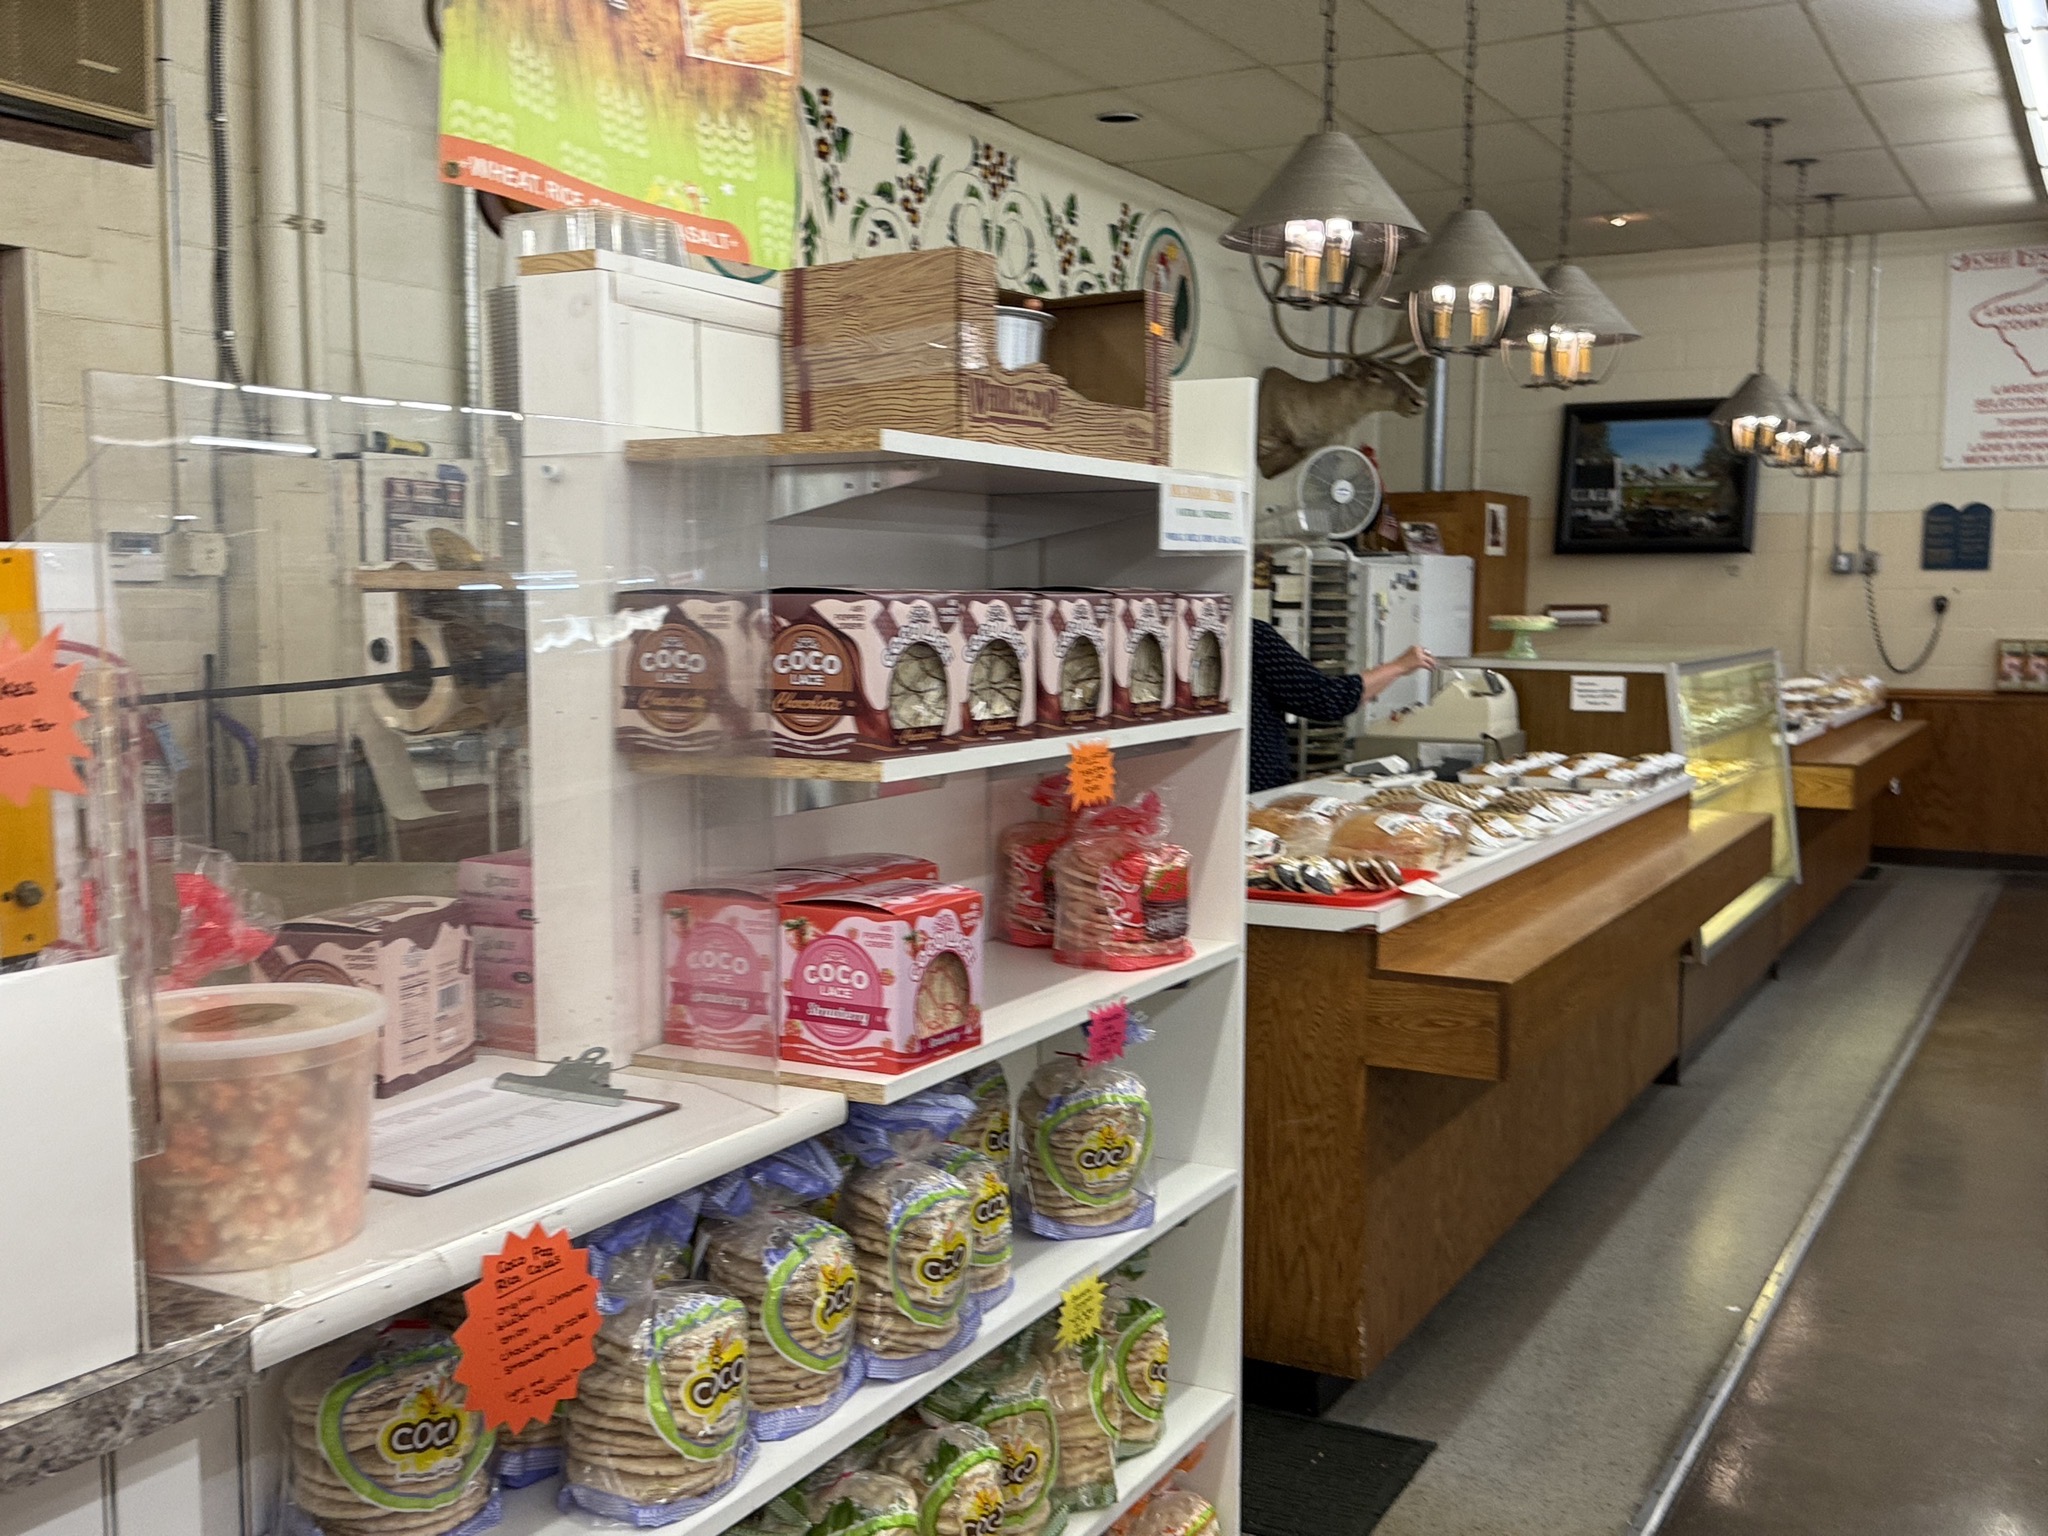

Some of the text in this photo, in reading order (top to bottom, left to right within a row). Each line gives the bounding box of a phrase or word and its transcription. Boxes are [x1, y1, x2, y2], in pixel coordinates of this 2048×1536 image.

[640, 649, 707, 673] COCO
[773, 650, 843, 675] COCO
[788, 672, 826, 687] LACE
[685, 950, 750, 975] COCO
[803, 963, 870, 990] COCO
[819, 985, 854, 999] LACE
